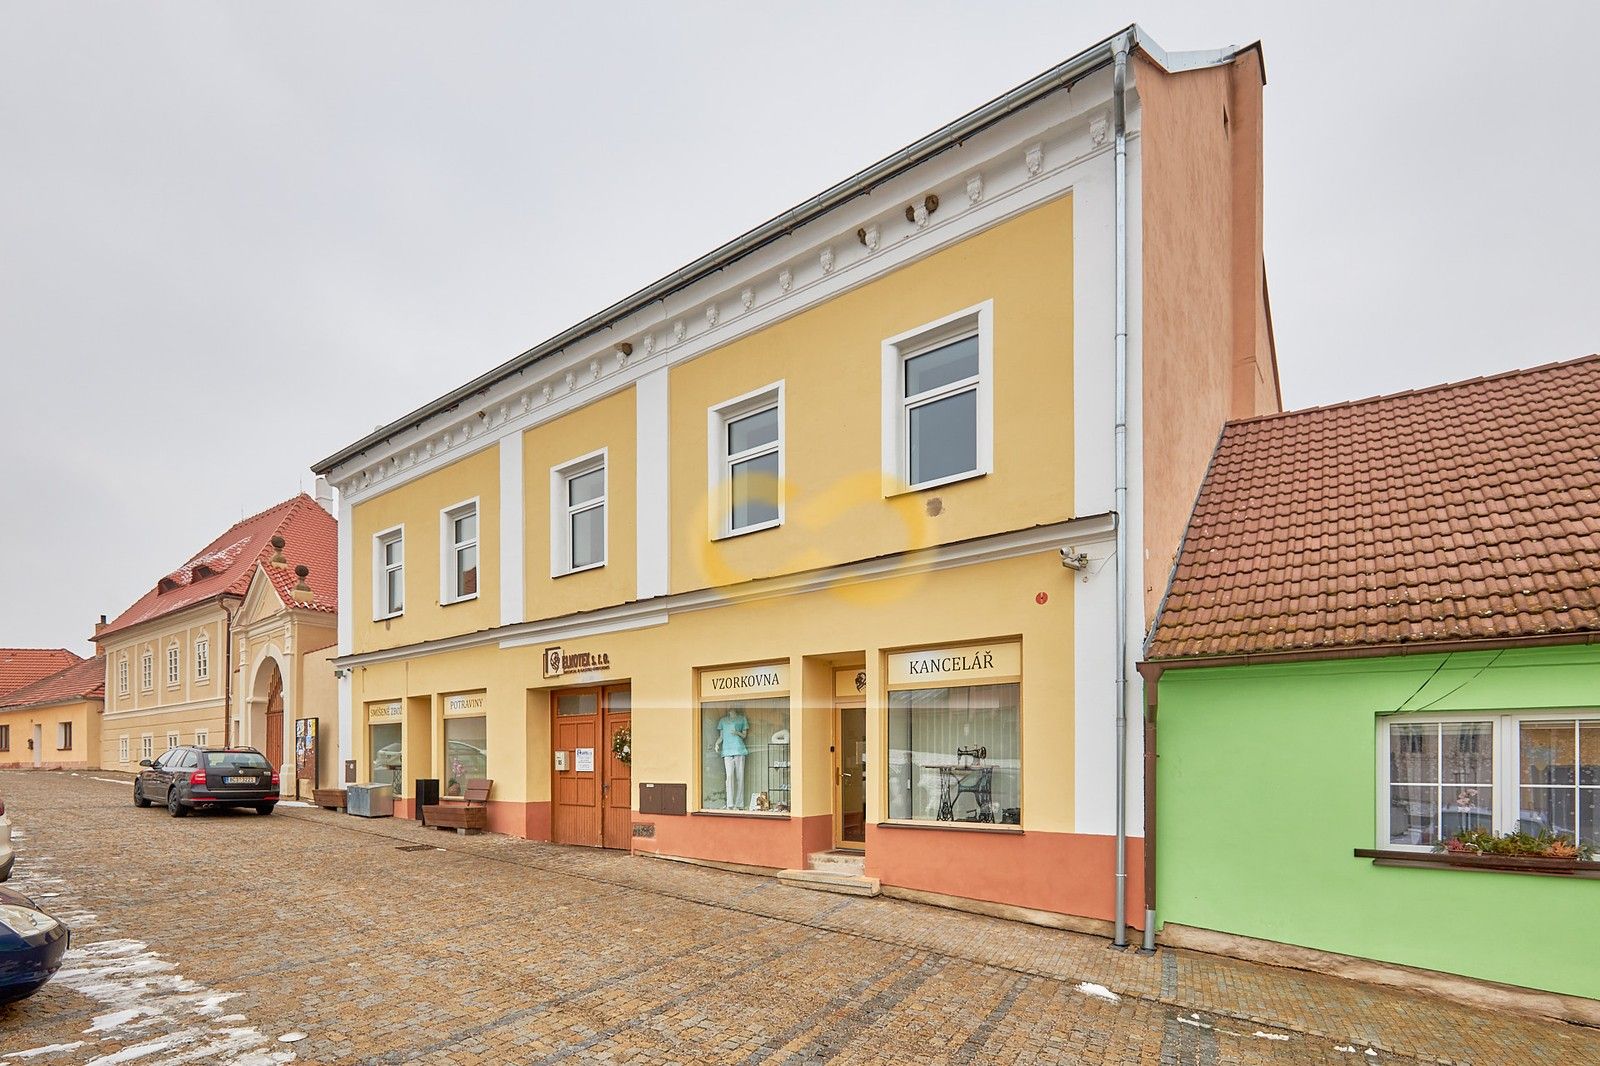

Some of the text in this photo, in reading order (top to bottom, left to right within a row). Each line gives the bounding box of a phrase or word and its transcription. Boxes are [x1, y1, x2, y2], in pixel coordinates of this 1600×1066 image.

[909, 650, 994, 675] KANCELÁŘ
[712, 673, 780, 690] VZORKOVNA
[450, 698, 484, 710] POTRAVINY
